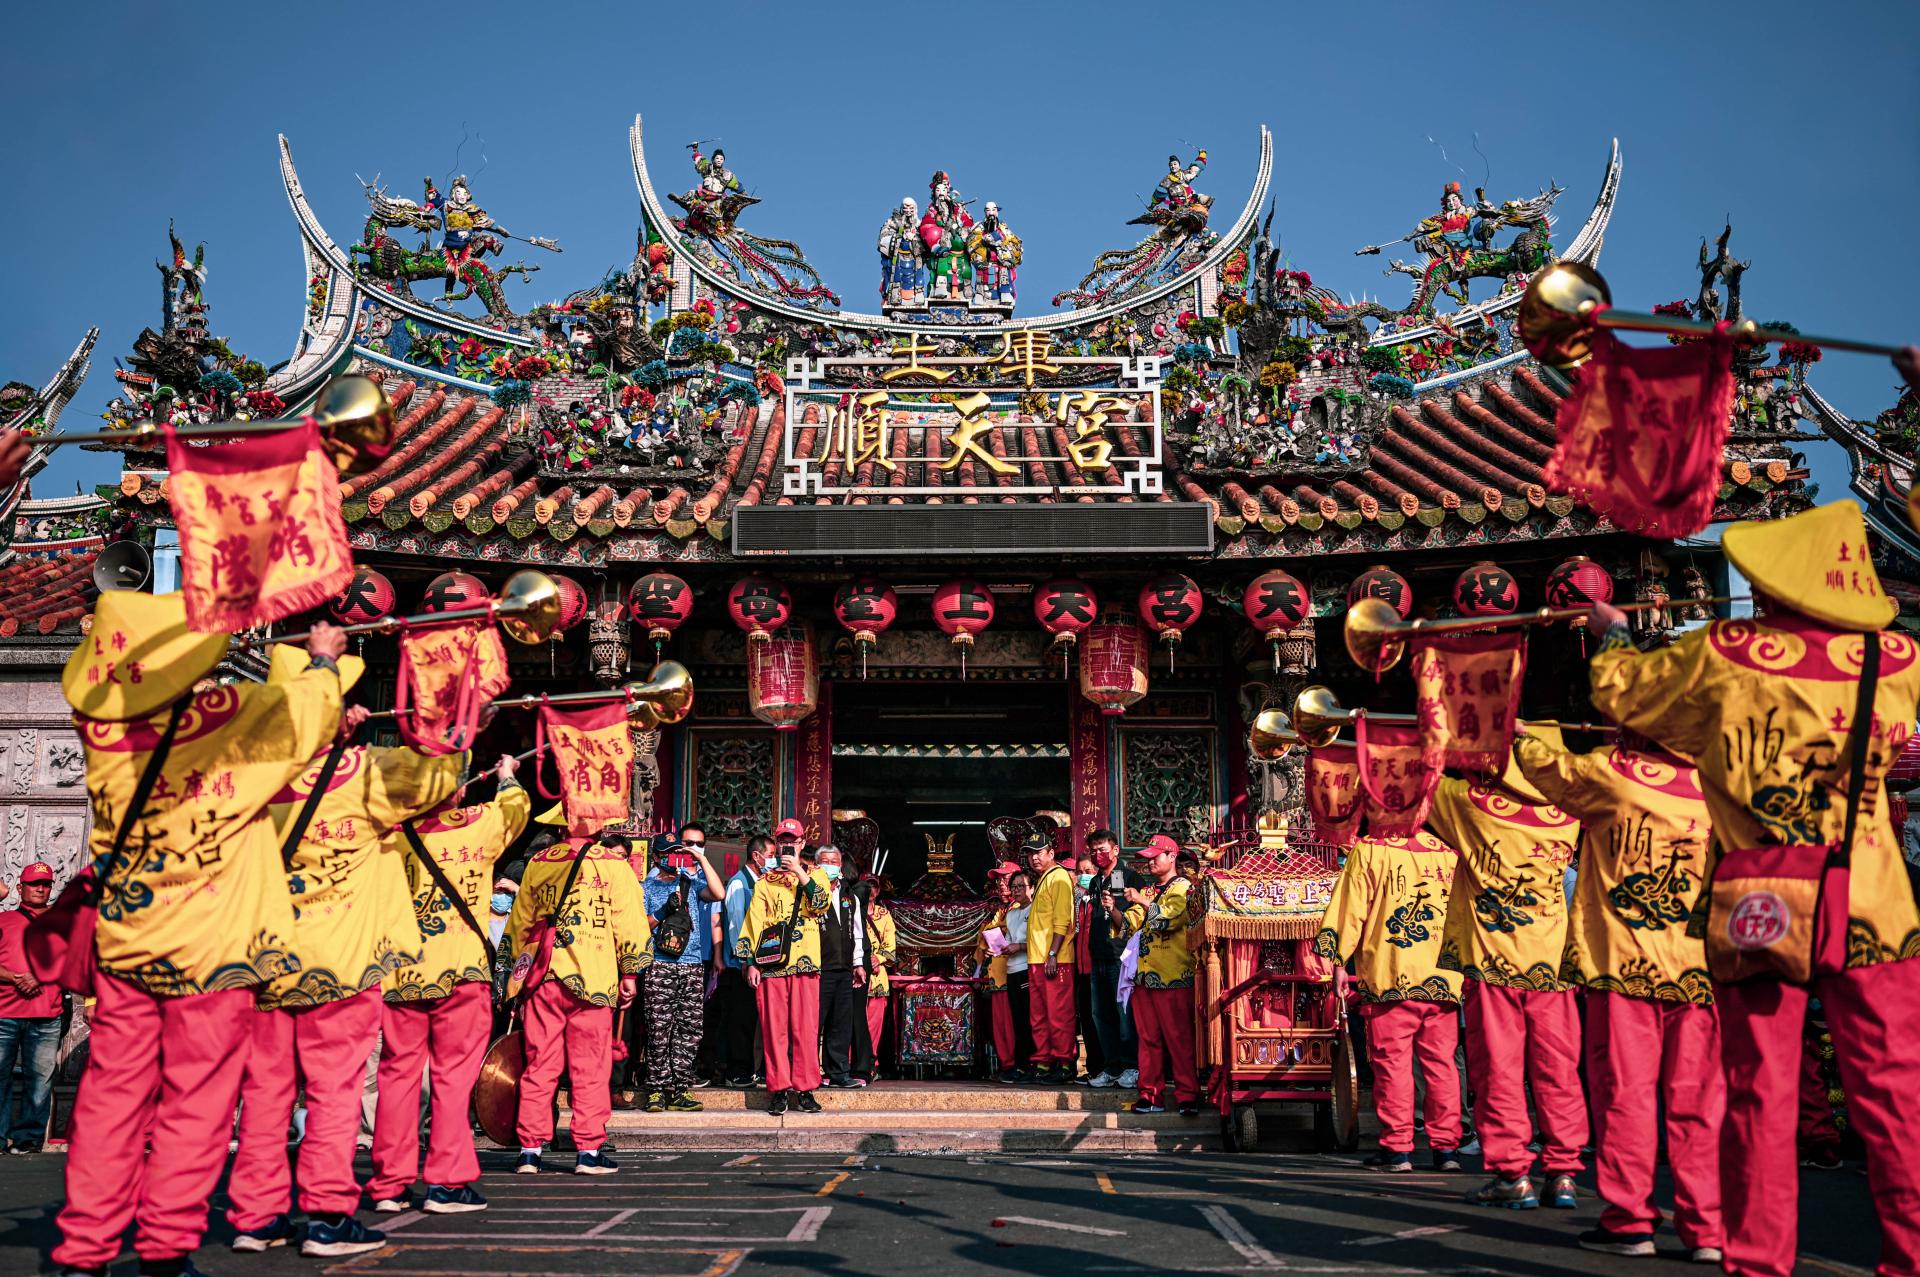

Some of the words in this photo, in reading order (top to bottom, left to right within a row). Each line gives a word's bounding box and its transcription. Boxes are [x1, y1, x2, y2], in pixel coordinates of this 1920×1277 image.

[883, 326, 1063, 388] 土庫
[818, 390, 1130, 476] 順天宮
[733, 580, 789, 622] 母
[943, 581, 989, 619] 上
[1044, 582, 1093, 623] 天
[1148, 576, 1194, 623] 宮
[1254, 581, 1302, 622] 天
[1459, 573, 1515, 614] 祝
